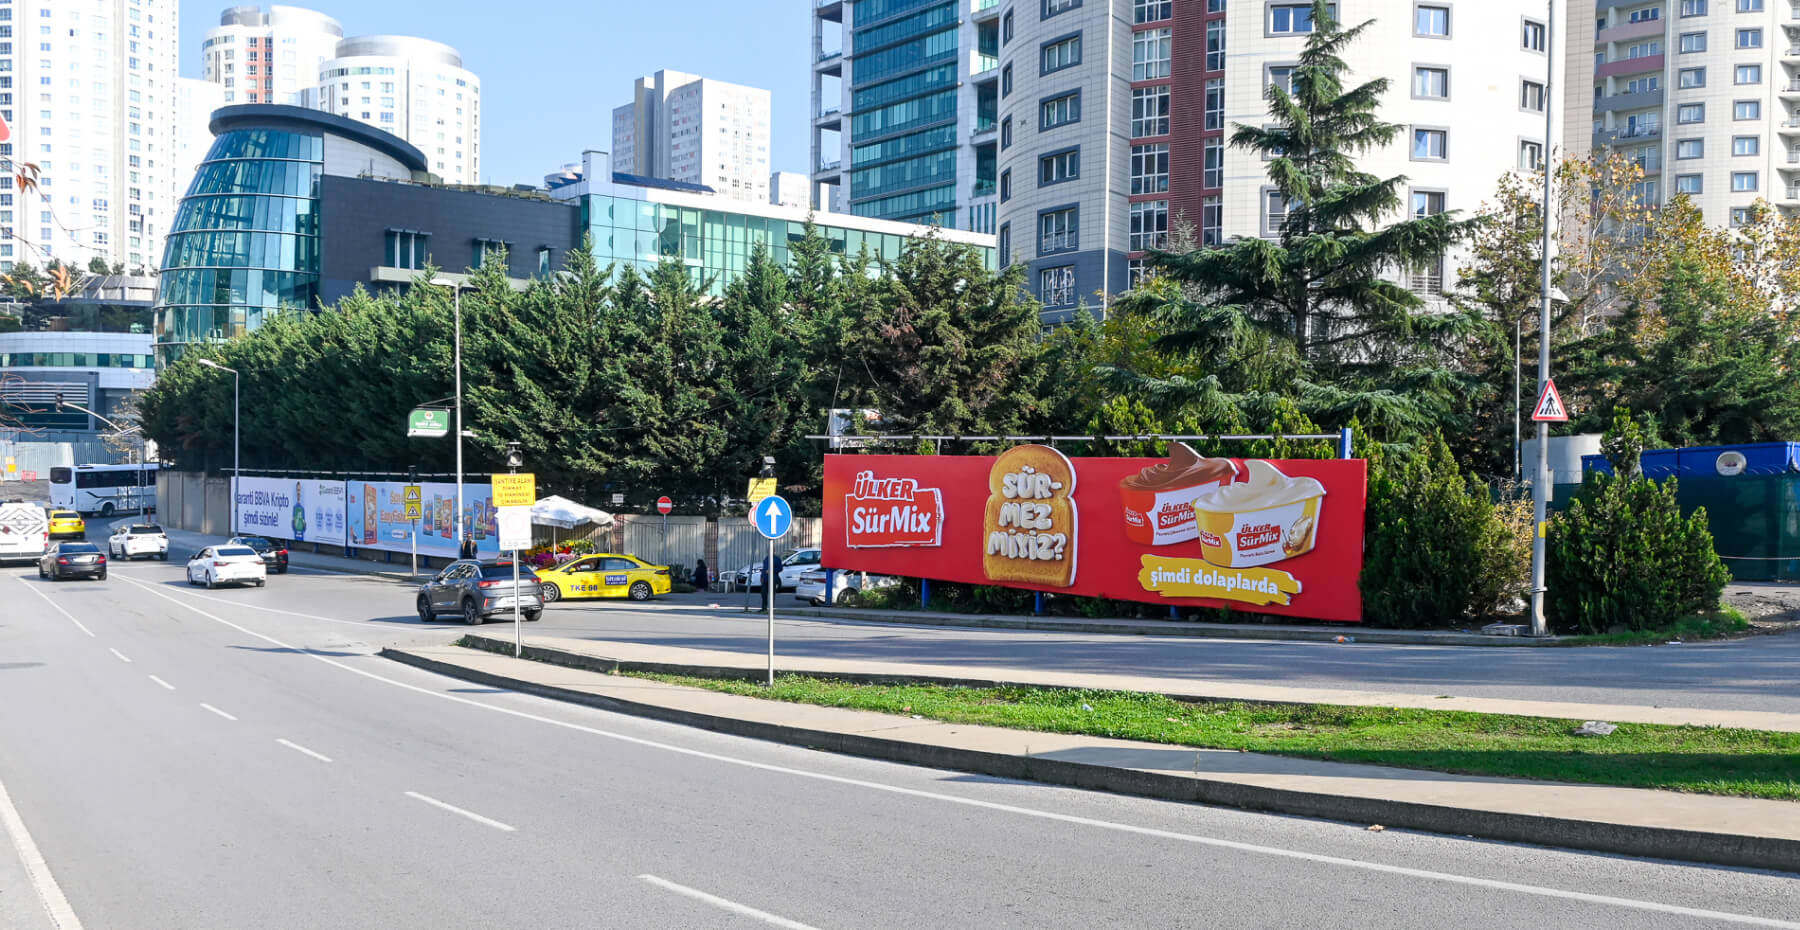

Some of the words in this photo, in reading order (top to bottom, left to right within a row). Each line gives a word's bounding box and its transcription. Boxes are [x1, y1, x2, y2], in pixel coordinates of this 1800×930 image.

[855, 471, 915, 501] ÜLKER
[1002, 465, 1063, 499] SÜR-
[254, 490, 270, 506] BBVA
[271, 491, 290, 511] Kripto
[243, 509, 259, 528] şimdi
[852, 505, 931, 535] SürMix
[998, 502, 1053, 530] MEZ
[1241, 523, 1272, 534] ÜLKER
[987, 528, 1067, 561] MİYİZ?
[1240, 531, 1280, 548] SürMix
[1150, 566, 1191, 588] şimdi
[1193, 568, 1279, 595] dolaplarda
